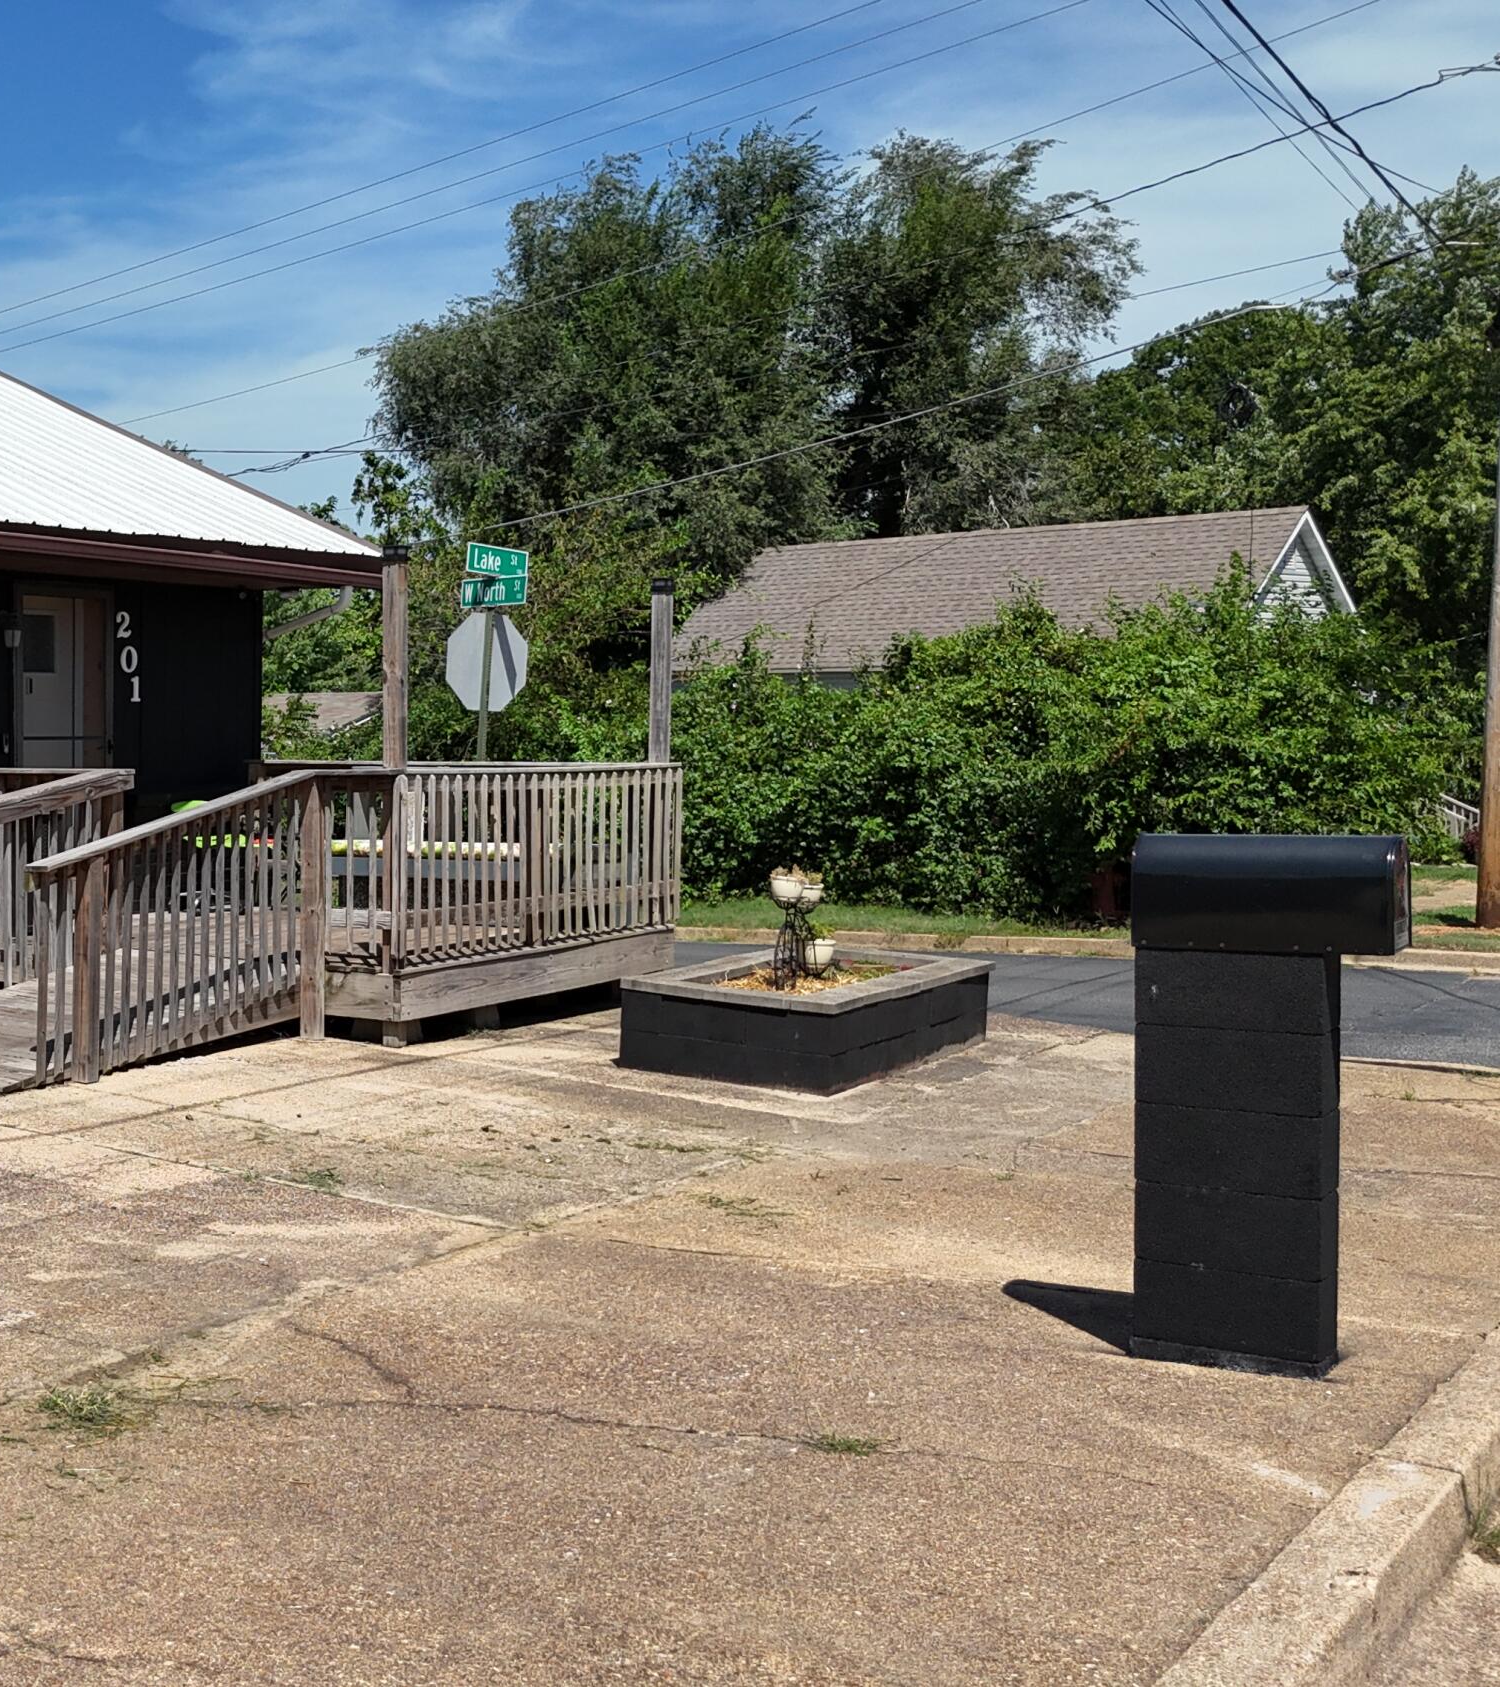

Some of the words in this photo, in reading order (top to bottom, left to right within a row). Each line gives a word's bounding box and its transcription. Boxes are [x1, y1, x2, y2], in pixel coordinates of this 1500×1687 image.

[473, 548, 501, 571] Lake
[510, 554, 518, 566] St
[464, 583, 474, 603] W
[476, 581, 506, 602] North
[513, 580, 521, 591] St
[115, 611, 141, 703] 201
